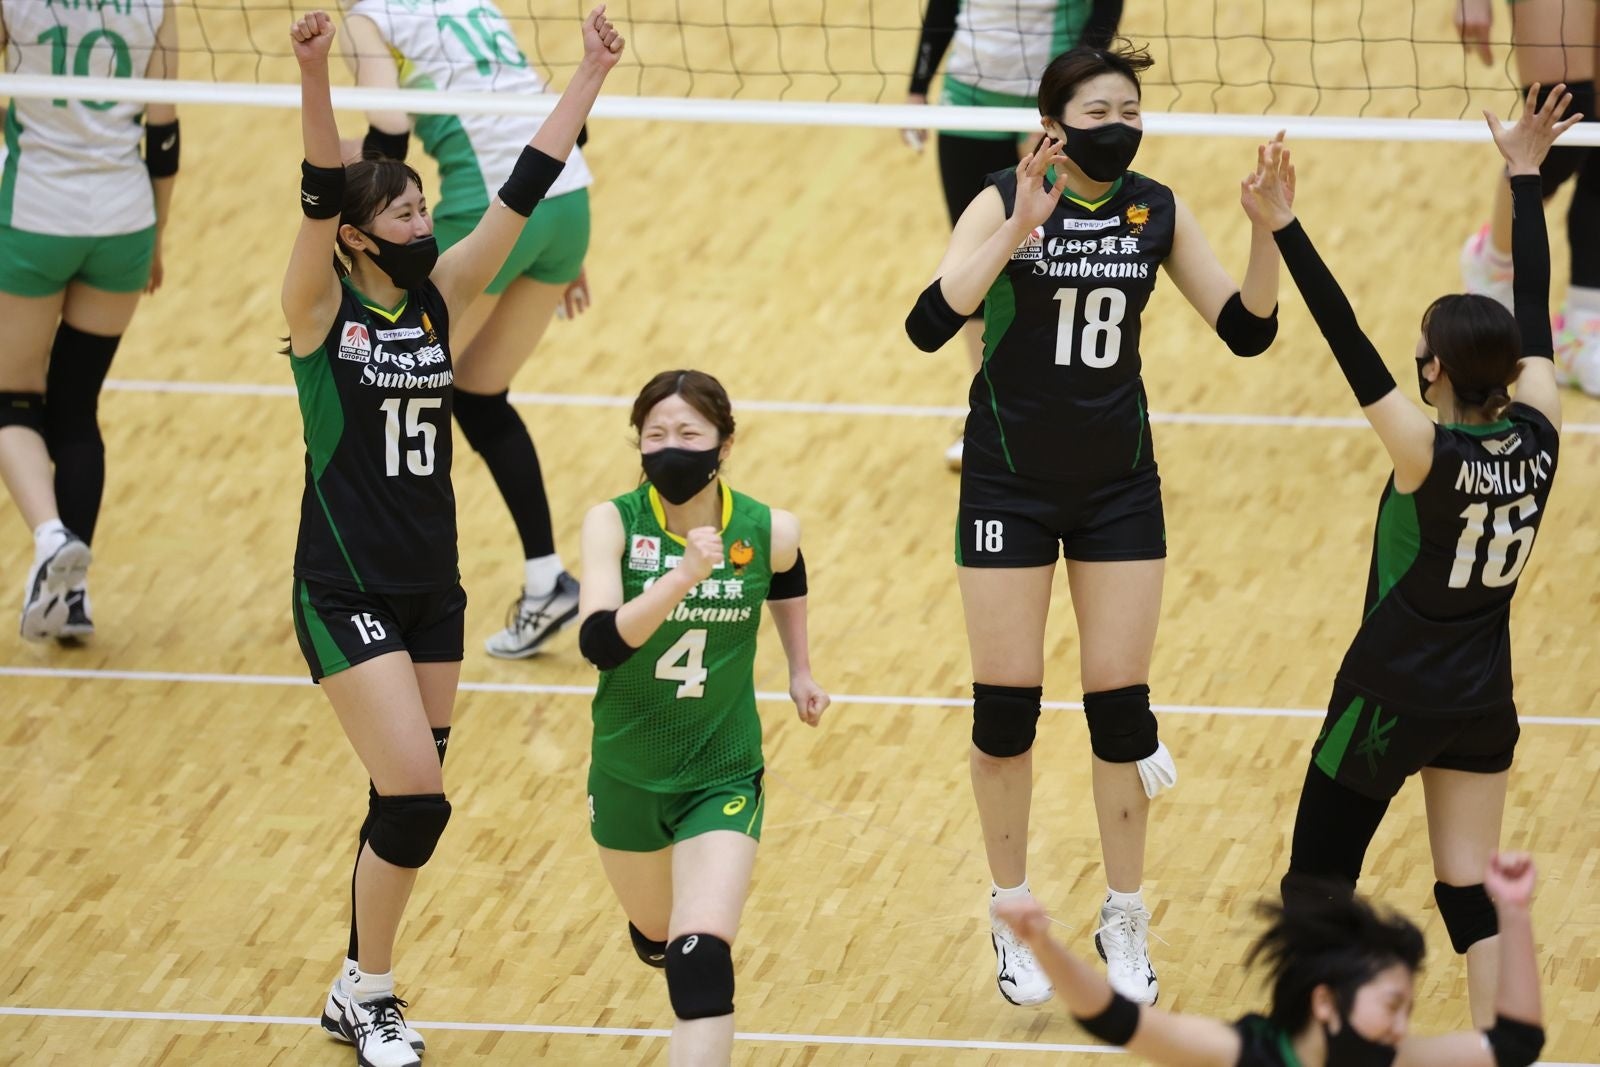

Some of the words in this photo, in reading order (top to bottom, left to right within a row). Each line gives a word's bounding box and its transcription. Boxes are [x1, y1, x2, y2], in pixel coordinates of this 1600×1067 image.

[37, 25, 132, 112] 10
[437, 7, 528, 76] 16
[1032, 257, 1149, 279] Sunbeams
[341, 352, 367, 361] LOTOPIA
[1052, 287, 1127, 369] 18
[360, 363, 453, 389] Sunbeams
[379, 398, 443, 477] 15
[973, 519, 1003, 553] 18
[1448, 494, 1538, 588] 16
[350, 612, 387, 645] 15
[654, 628, 708, 699] 4
